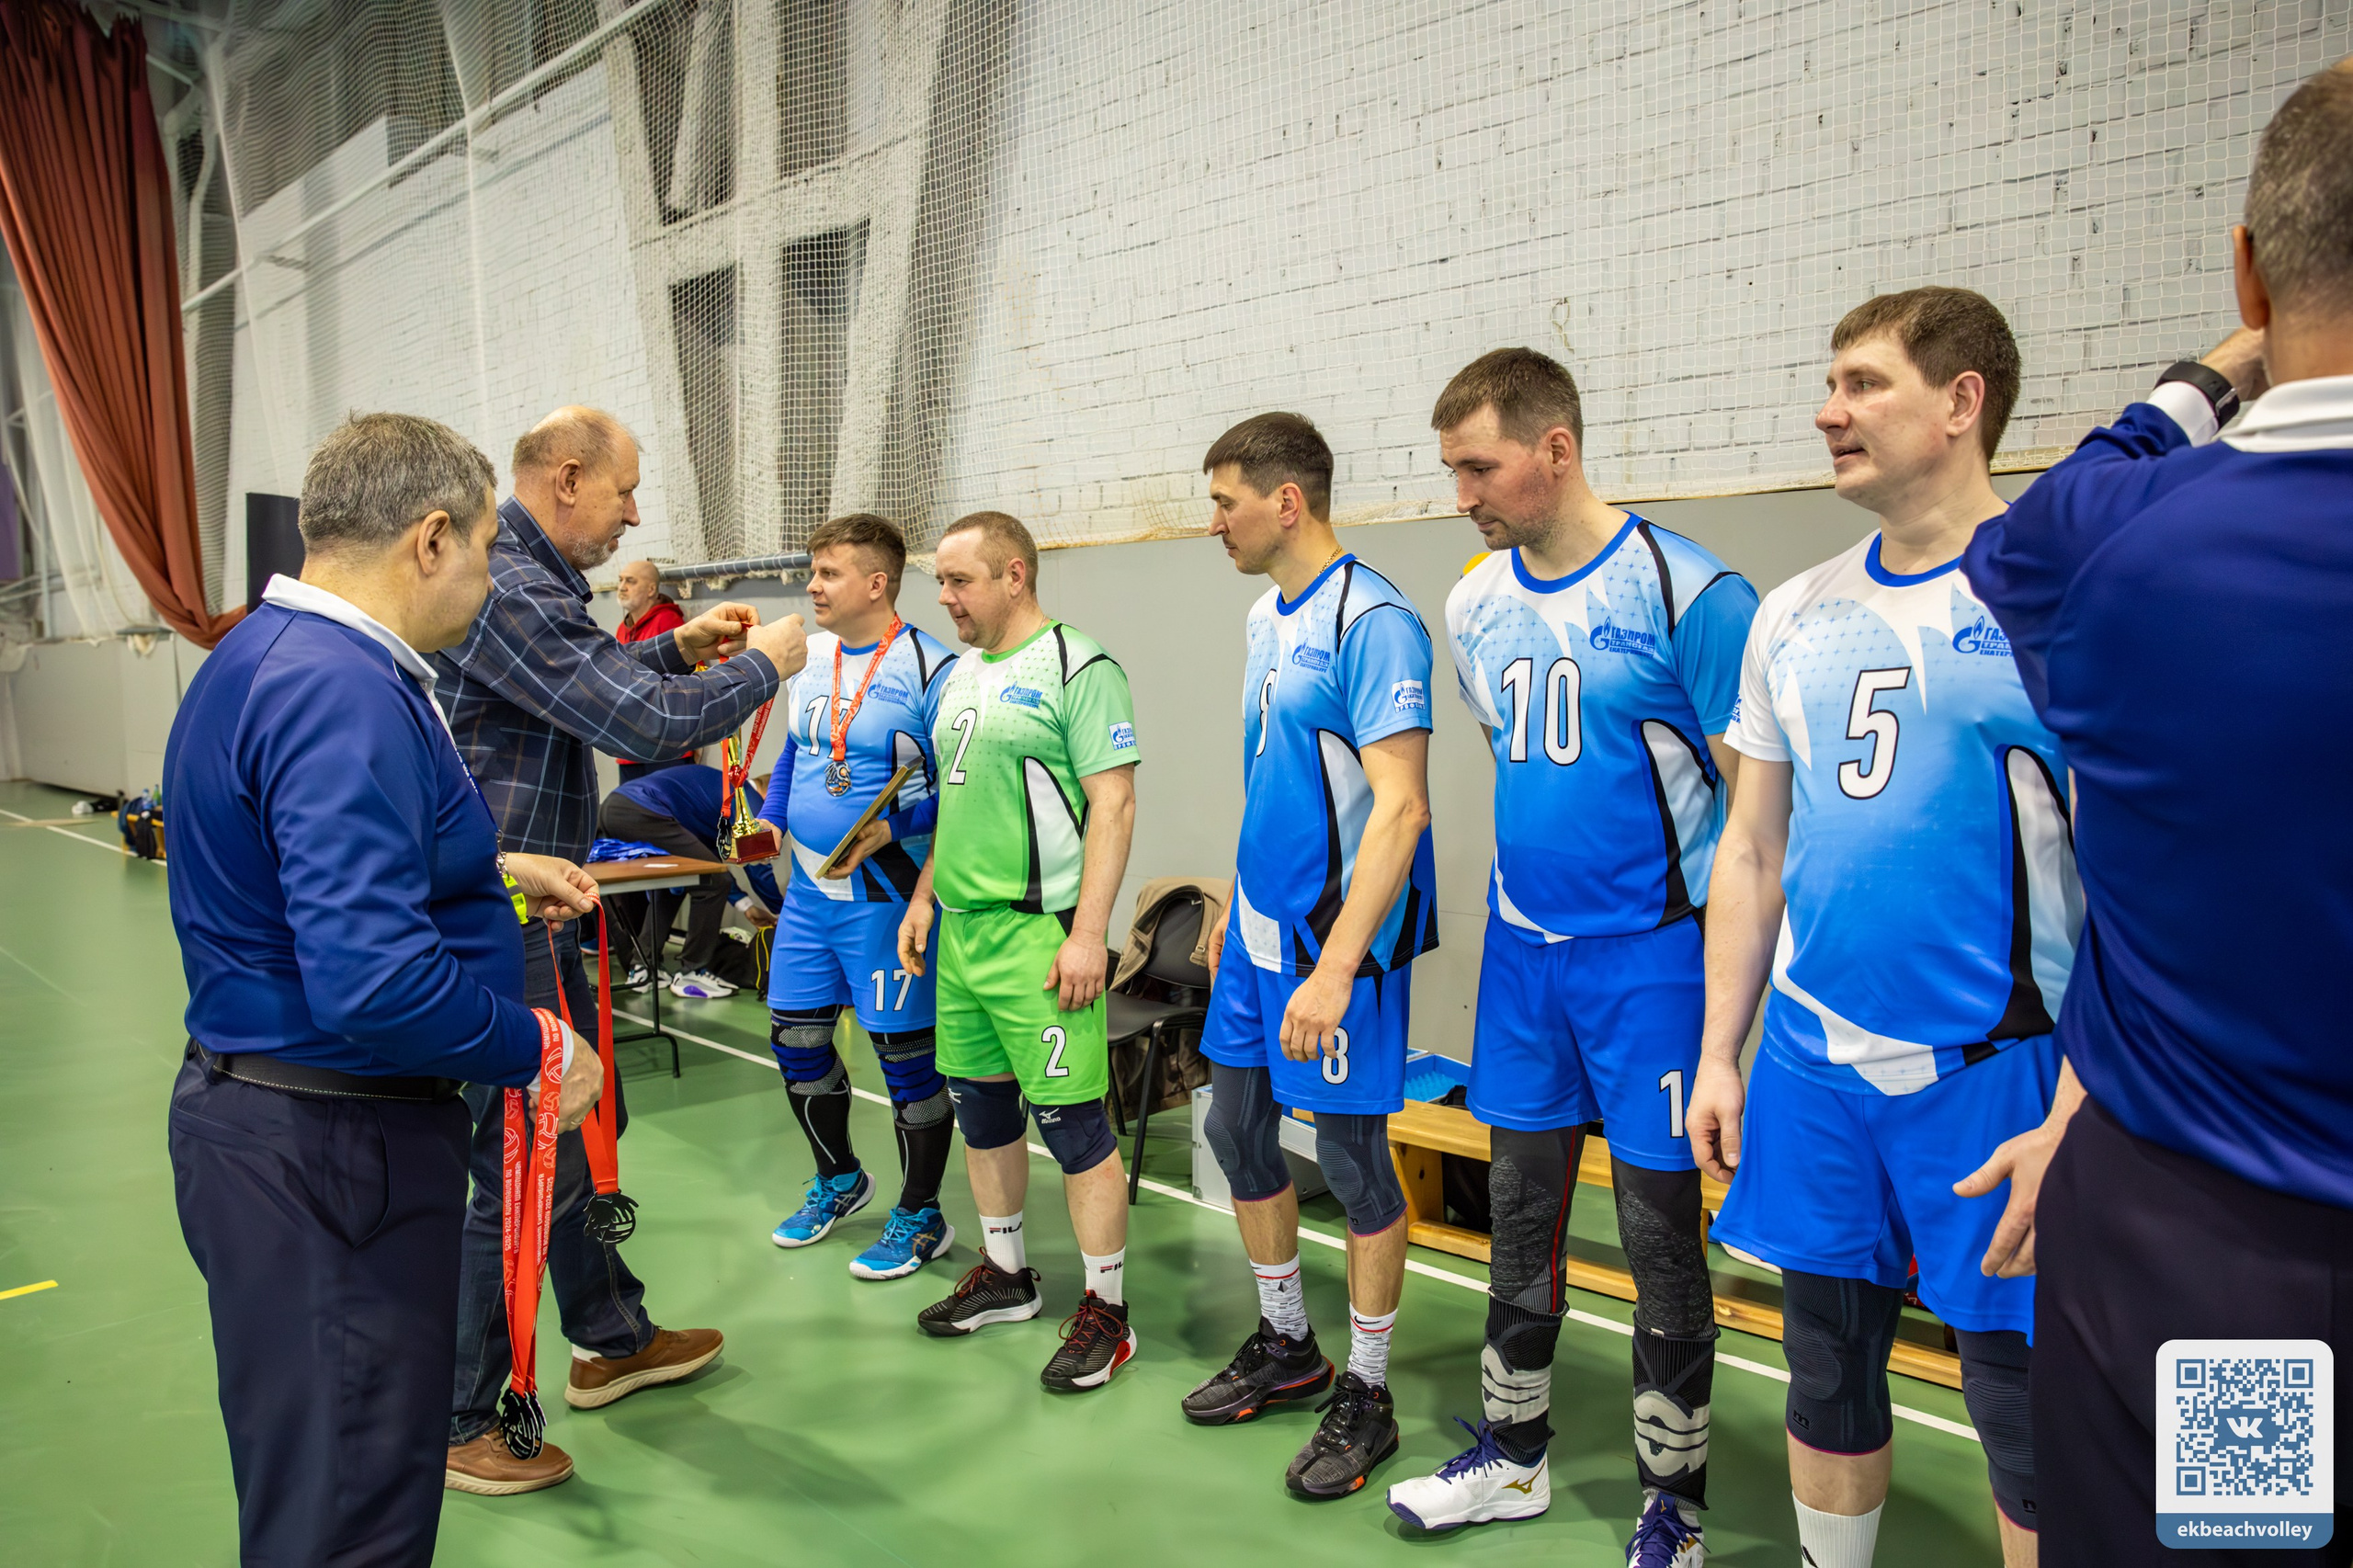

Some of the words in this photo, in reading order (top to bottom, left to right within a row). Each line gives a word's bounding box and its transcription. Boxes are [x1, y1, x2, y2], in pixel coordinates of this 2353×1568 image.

[1304, 646, 1330, 662] ГАЗПРОМ
[1610, 638, 1654, 654] ТРАНСГАЗ
[1611, 626, 1655, 646] ГАЗПРОМ
[1500, 656, 1583, 766] 10
[1838, 665, 1912, 800] 5
[947, 708, 977, 785] 2
[870, 969, 913, 1011] 17
[1041, 1025, 1069, 1077] 2
[1321, 1025, 1350, 1085] 8
[1659, 1069, 1687, 1138] 1
